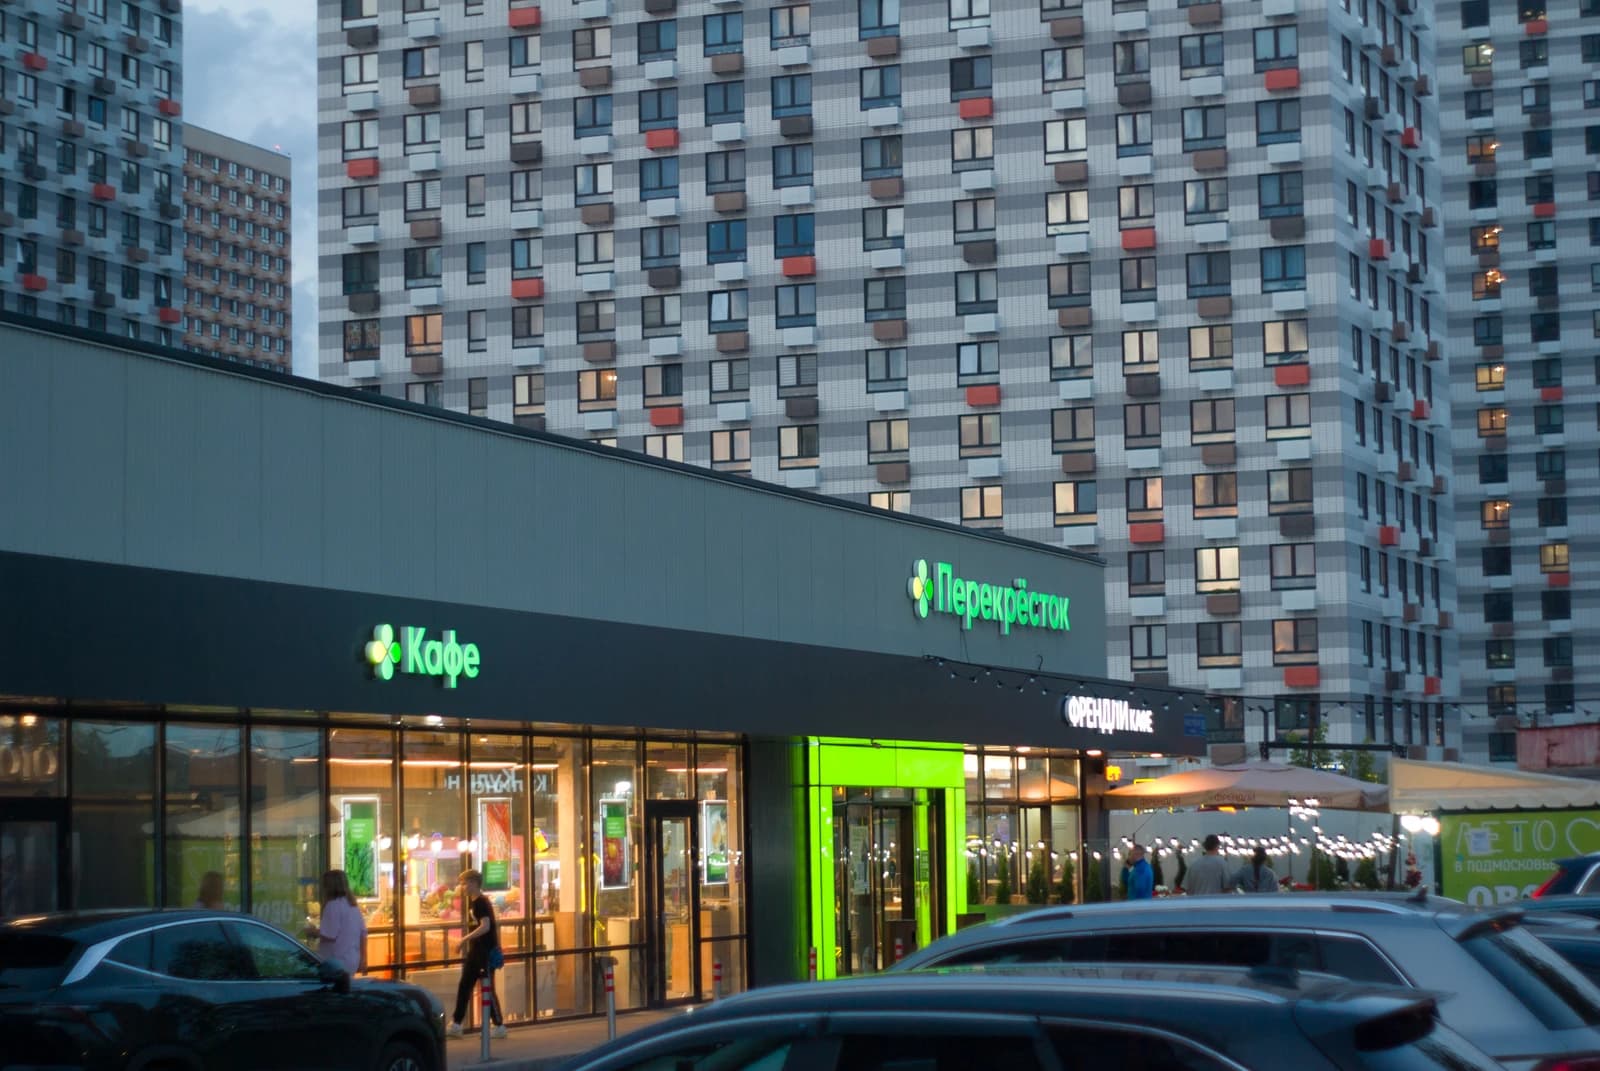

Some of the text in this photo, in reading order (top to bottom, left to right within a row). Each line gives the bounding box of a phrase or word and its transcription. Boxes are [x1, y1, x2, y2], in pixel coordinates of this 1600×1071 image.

[934, 562, 1070, 635] Перекрёсток
[402, 626, 480, 688] Кафе
[1066, 695, 1129, 734] ФРЕНДЛИ
